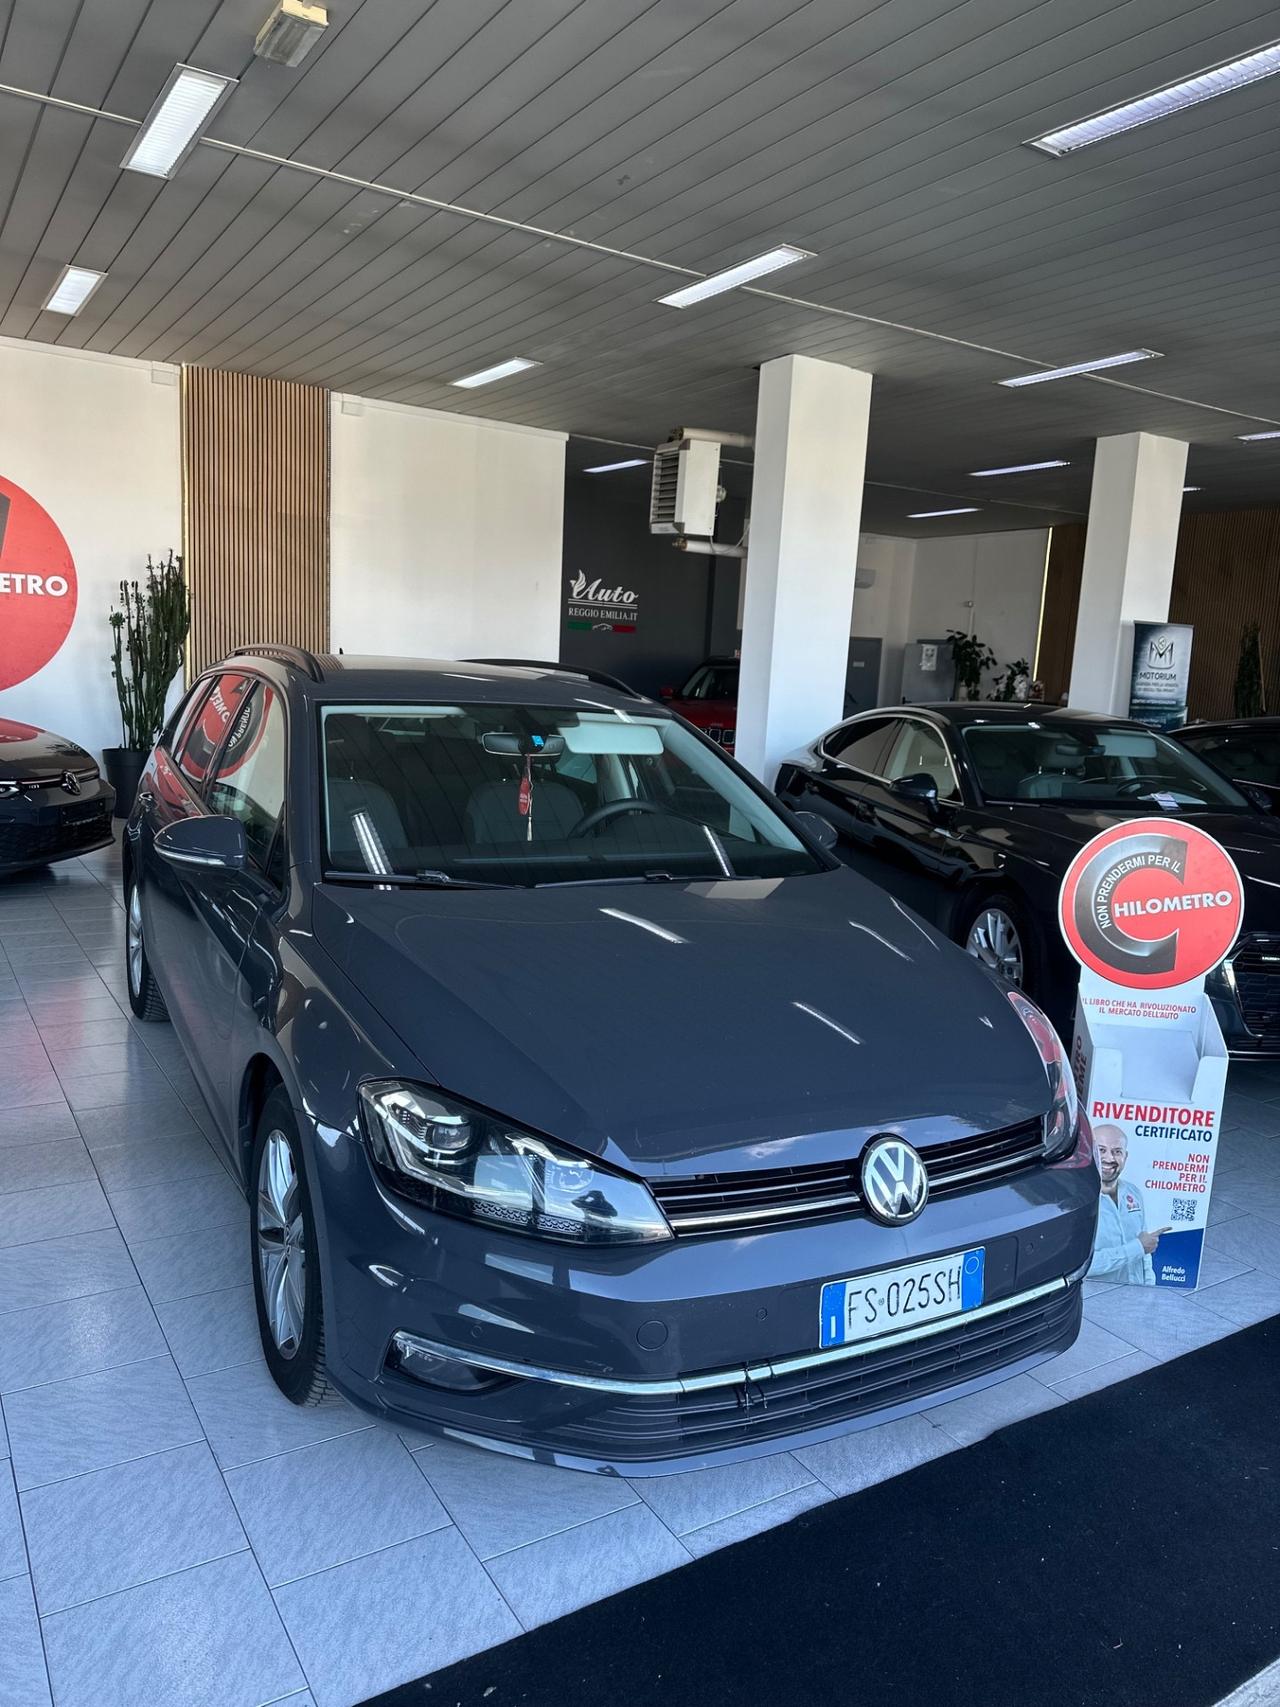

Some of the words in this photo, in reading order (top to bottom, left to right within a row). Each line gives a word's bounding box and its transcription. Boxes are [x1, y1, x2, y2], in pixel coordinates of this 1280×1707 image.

[572, 577, 639, 603] Auto
[568, 607, 599, 618] REGGIO
[1139, 671, 1177, 680] MOTORIUM
[1148, 855, 1171, 867] PER
[1170, 862, 1181, 873] IL
[1097, 856, 1146, 905] PRENDERMI
[1097, 905, 1112, 929] NON
[1089, 998, 1111, 1006] LIBRO
[1112, 1000, 1125, 1008] CHE
[1139, 1002, 1197, 1014] RIVOLUZIONATO
[1108, 1008, 1141, 1017] MERCATO
[1142, 1010, 1179, 1020] DELL'AUTO
[1092, 1101, 1216, 1127] RIVENDITORE
[1135, 1124, 1212, 1143] CERTIFICATO
[1188, 1153, 1210, 1164] NON
[1152, 1160, 1209, 1174] PRENDERMI
[1179, 1173, 1197, 1183] PER
[1144, 1179, 1206, 1193] CHILOMETRO
[1161, 1265, 1186, 1275] Alfredo
[1161, 1274, 1186, 1283] Bellucci
